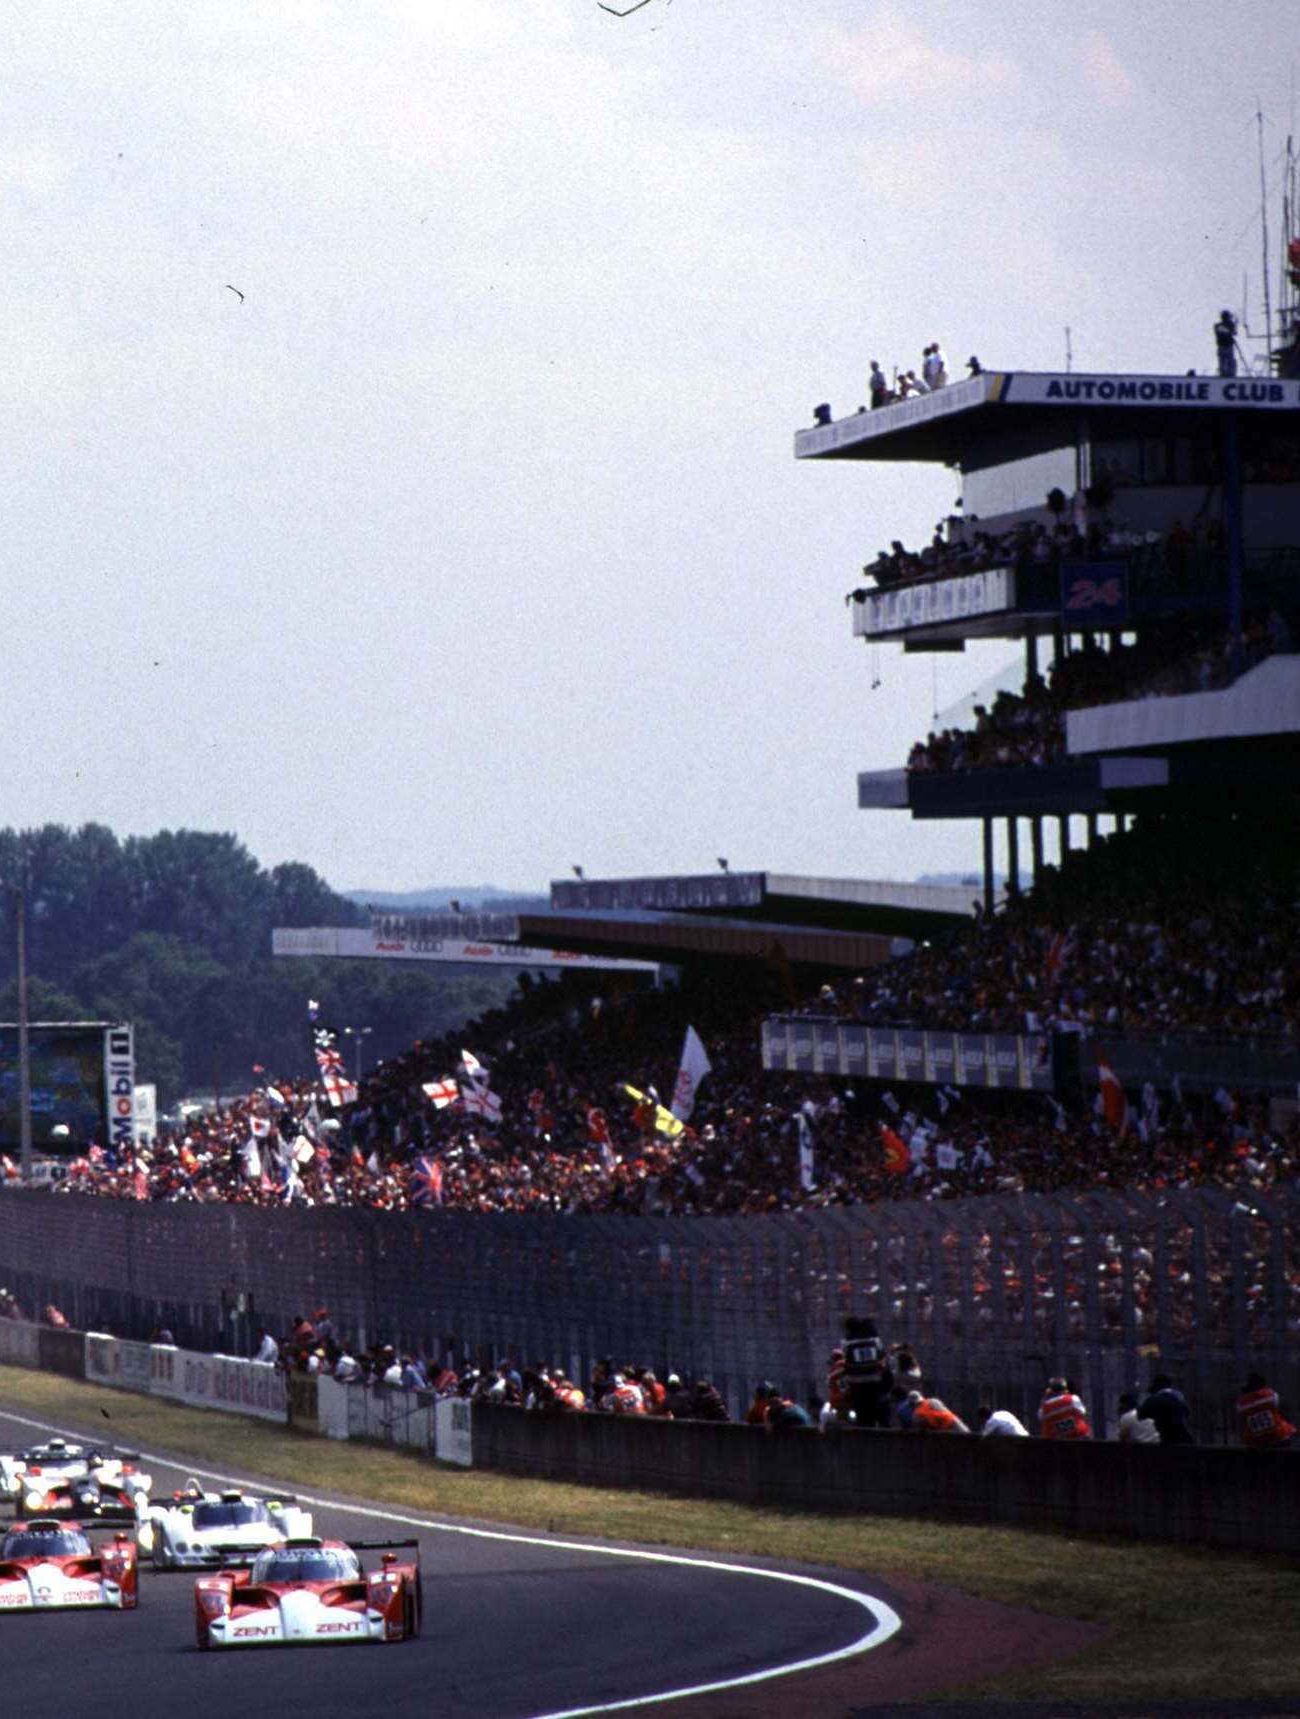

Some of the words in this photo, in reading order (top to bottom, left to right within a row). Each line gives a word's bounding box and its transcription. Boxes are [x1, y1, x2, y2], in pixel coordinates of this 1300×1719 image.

[1046, 380, 1210, 401] AUTOMOBILE
[1222, 382, 1285, 402] CLUB
[111, 1061, 133, 1143] Mobil
[233, 1625, 278, 1638] ZENT
[316, 1621, 363, 1633] ZENT
